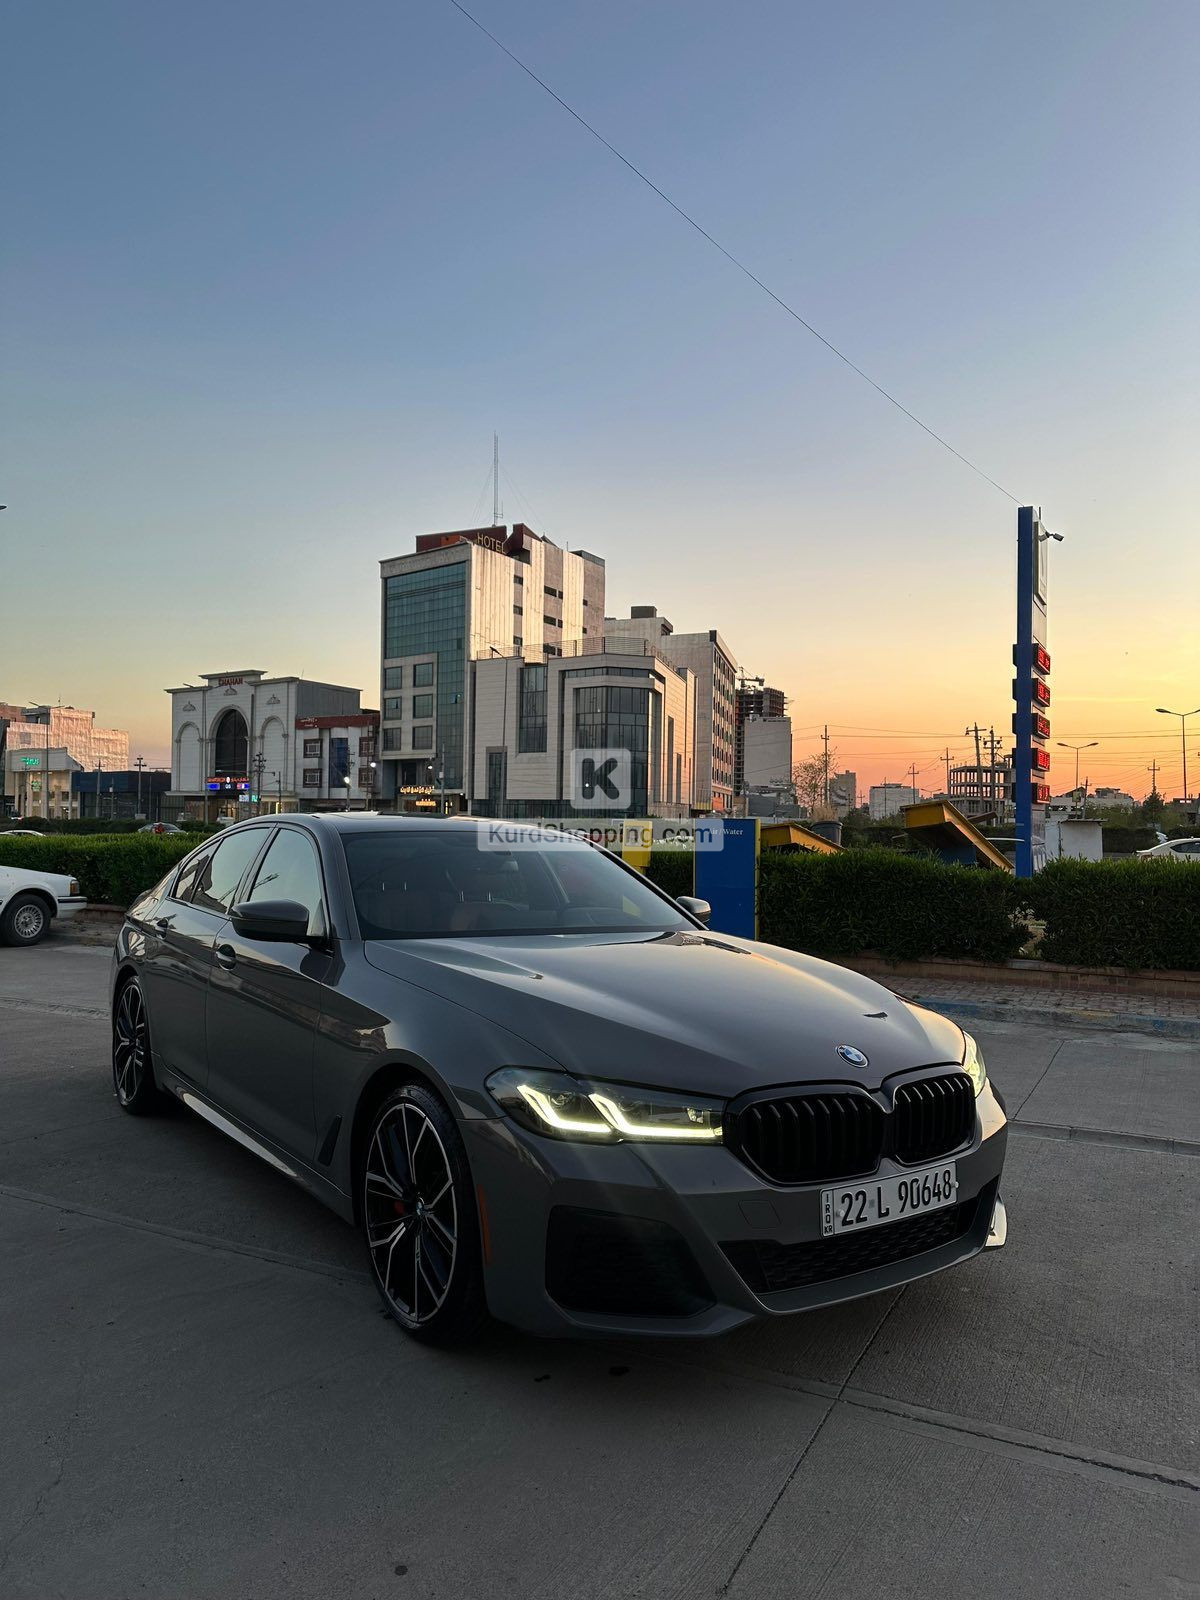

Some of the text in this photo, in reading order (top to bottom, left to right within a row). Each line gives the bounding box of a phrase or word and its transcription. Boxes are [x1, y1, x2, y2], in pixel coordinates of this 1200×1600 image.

[477, 532, 506, 554] HOTEL
[841, 1169, 952, 1226] 22 L 90648
